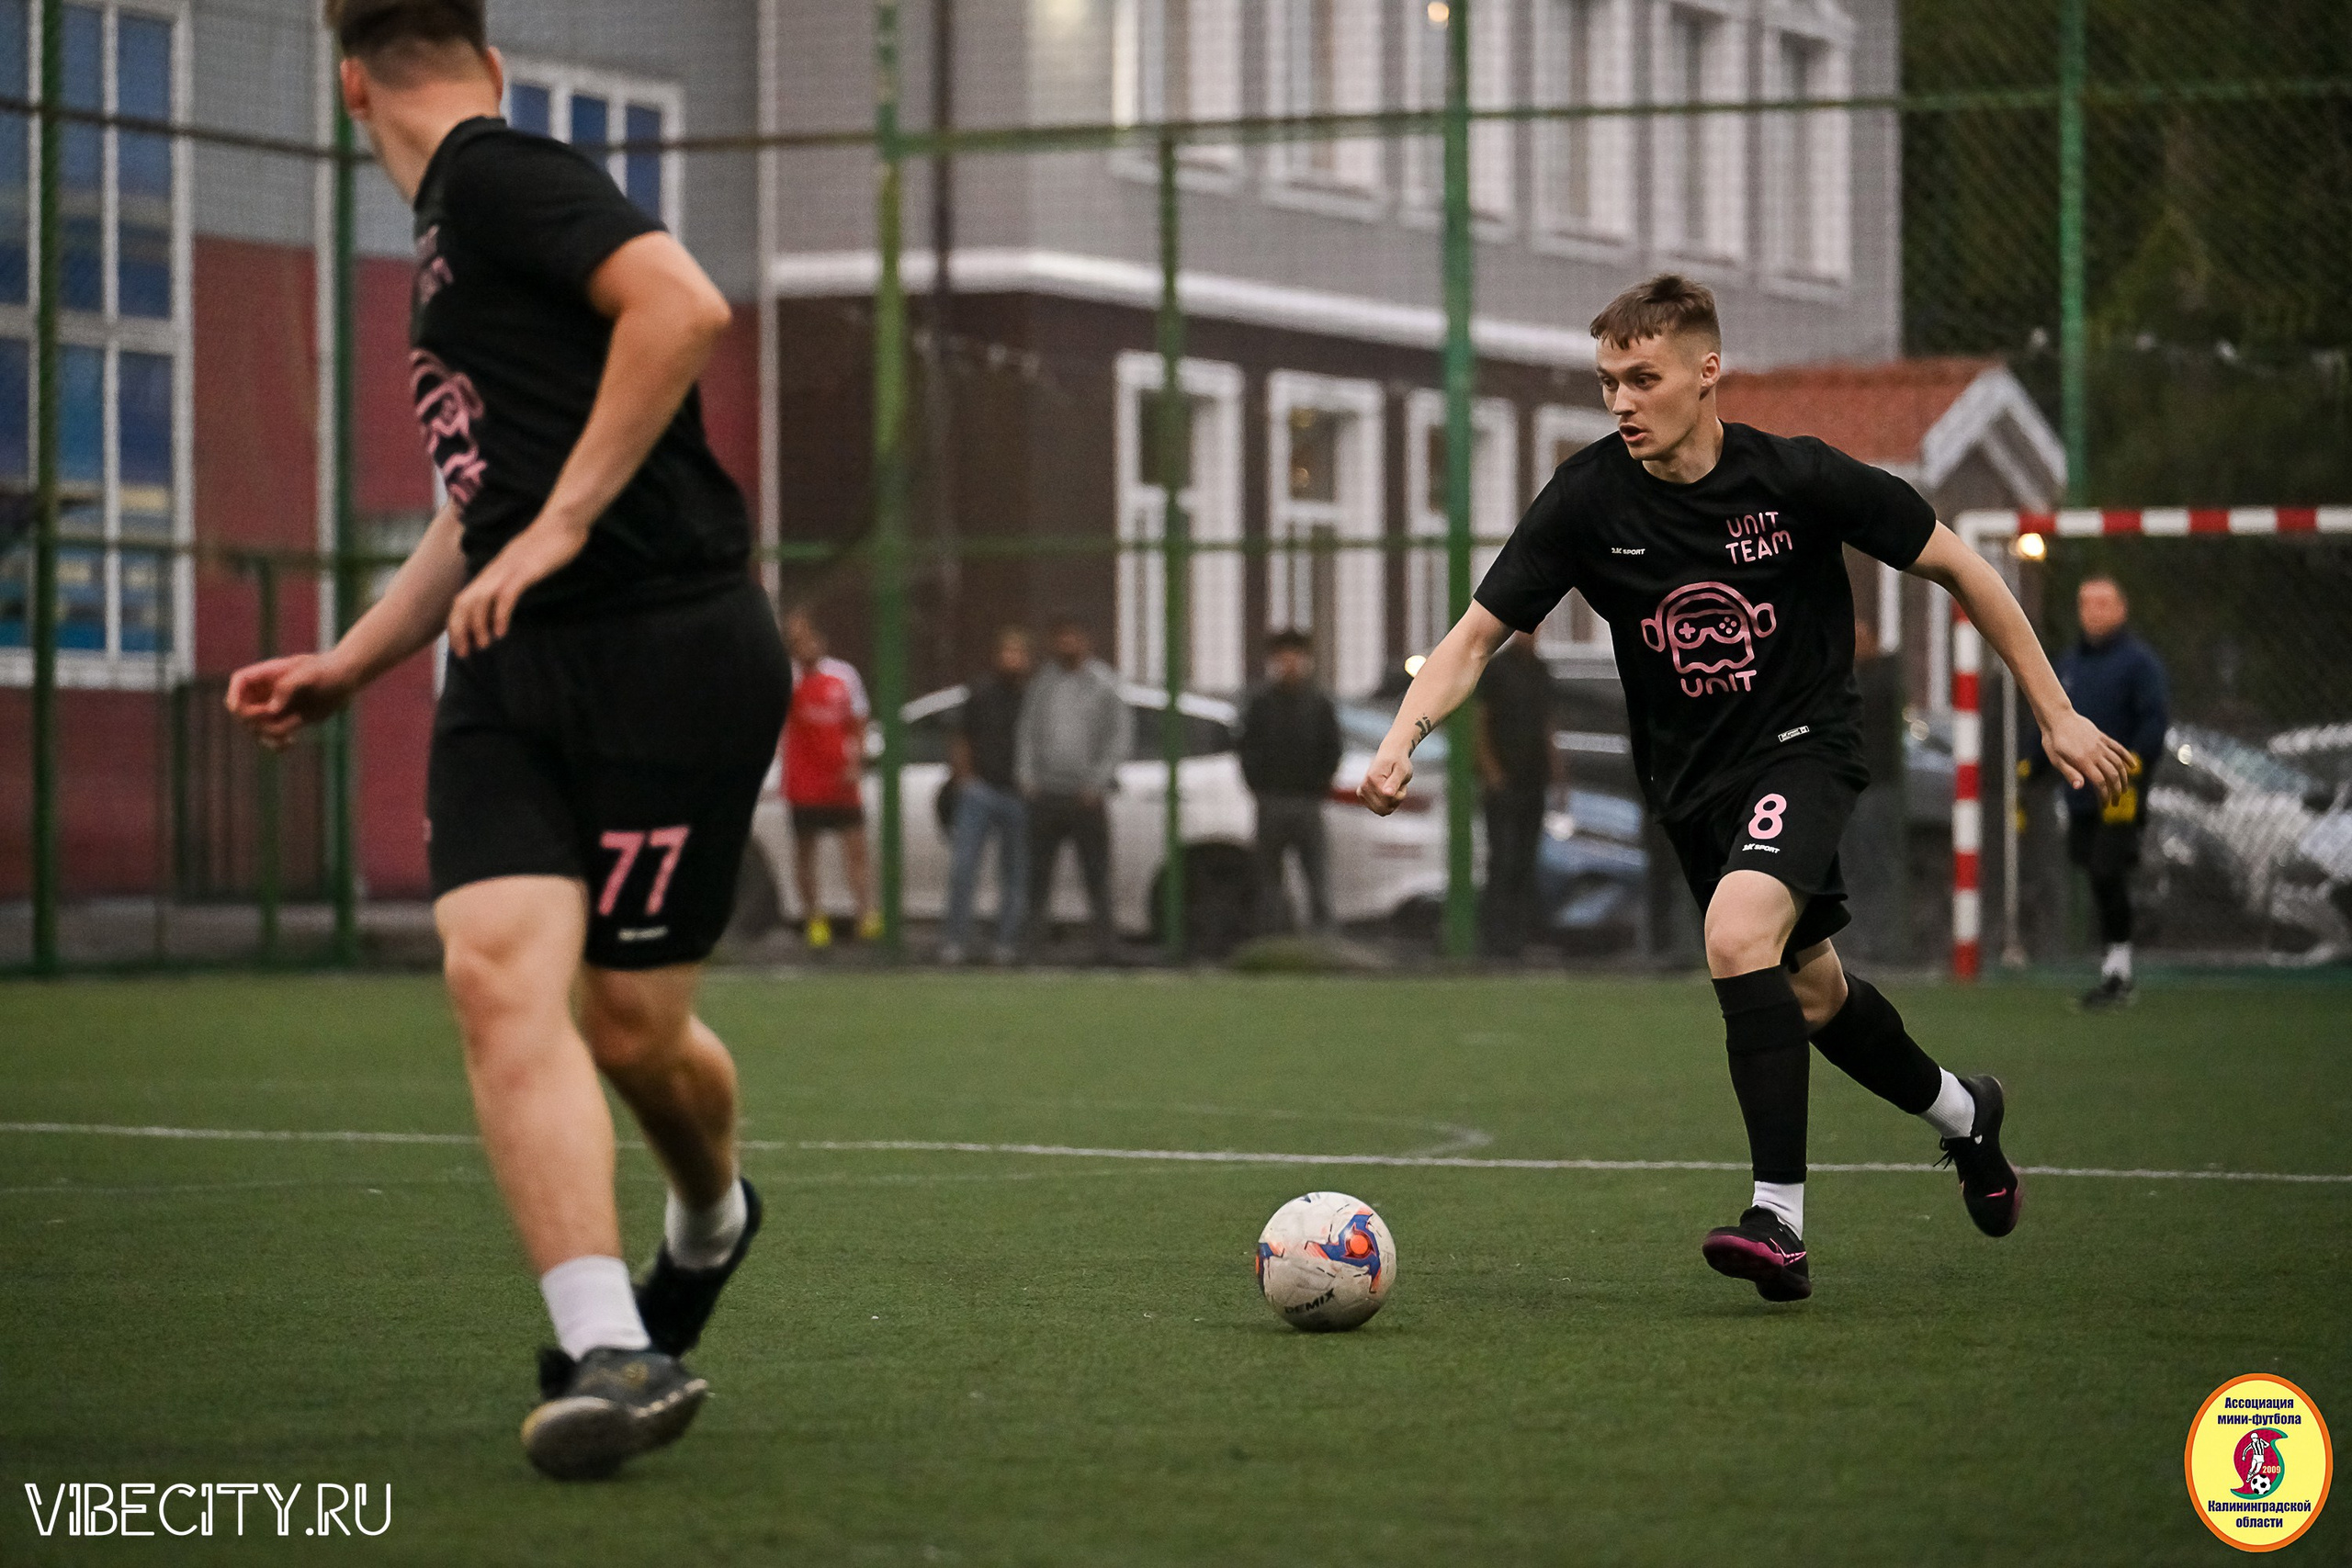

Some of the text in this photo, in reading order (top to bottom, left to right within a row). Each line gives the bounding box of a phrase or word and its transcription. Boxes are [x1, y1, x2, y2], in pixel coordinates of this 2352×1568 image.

[1726, 511, 1779, 538] UNIT
[1623, 547, 1645, 556] SPORT
[1725, 530, 1792, 565] TEAM
[1680, 670, 1758, 698] UNIT
[1747, 793, 1788, 840] 8
[598, 825, 691, 917] 77
